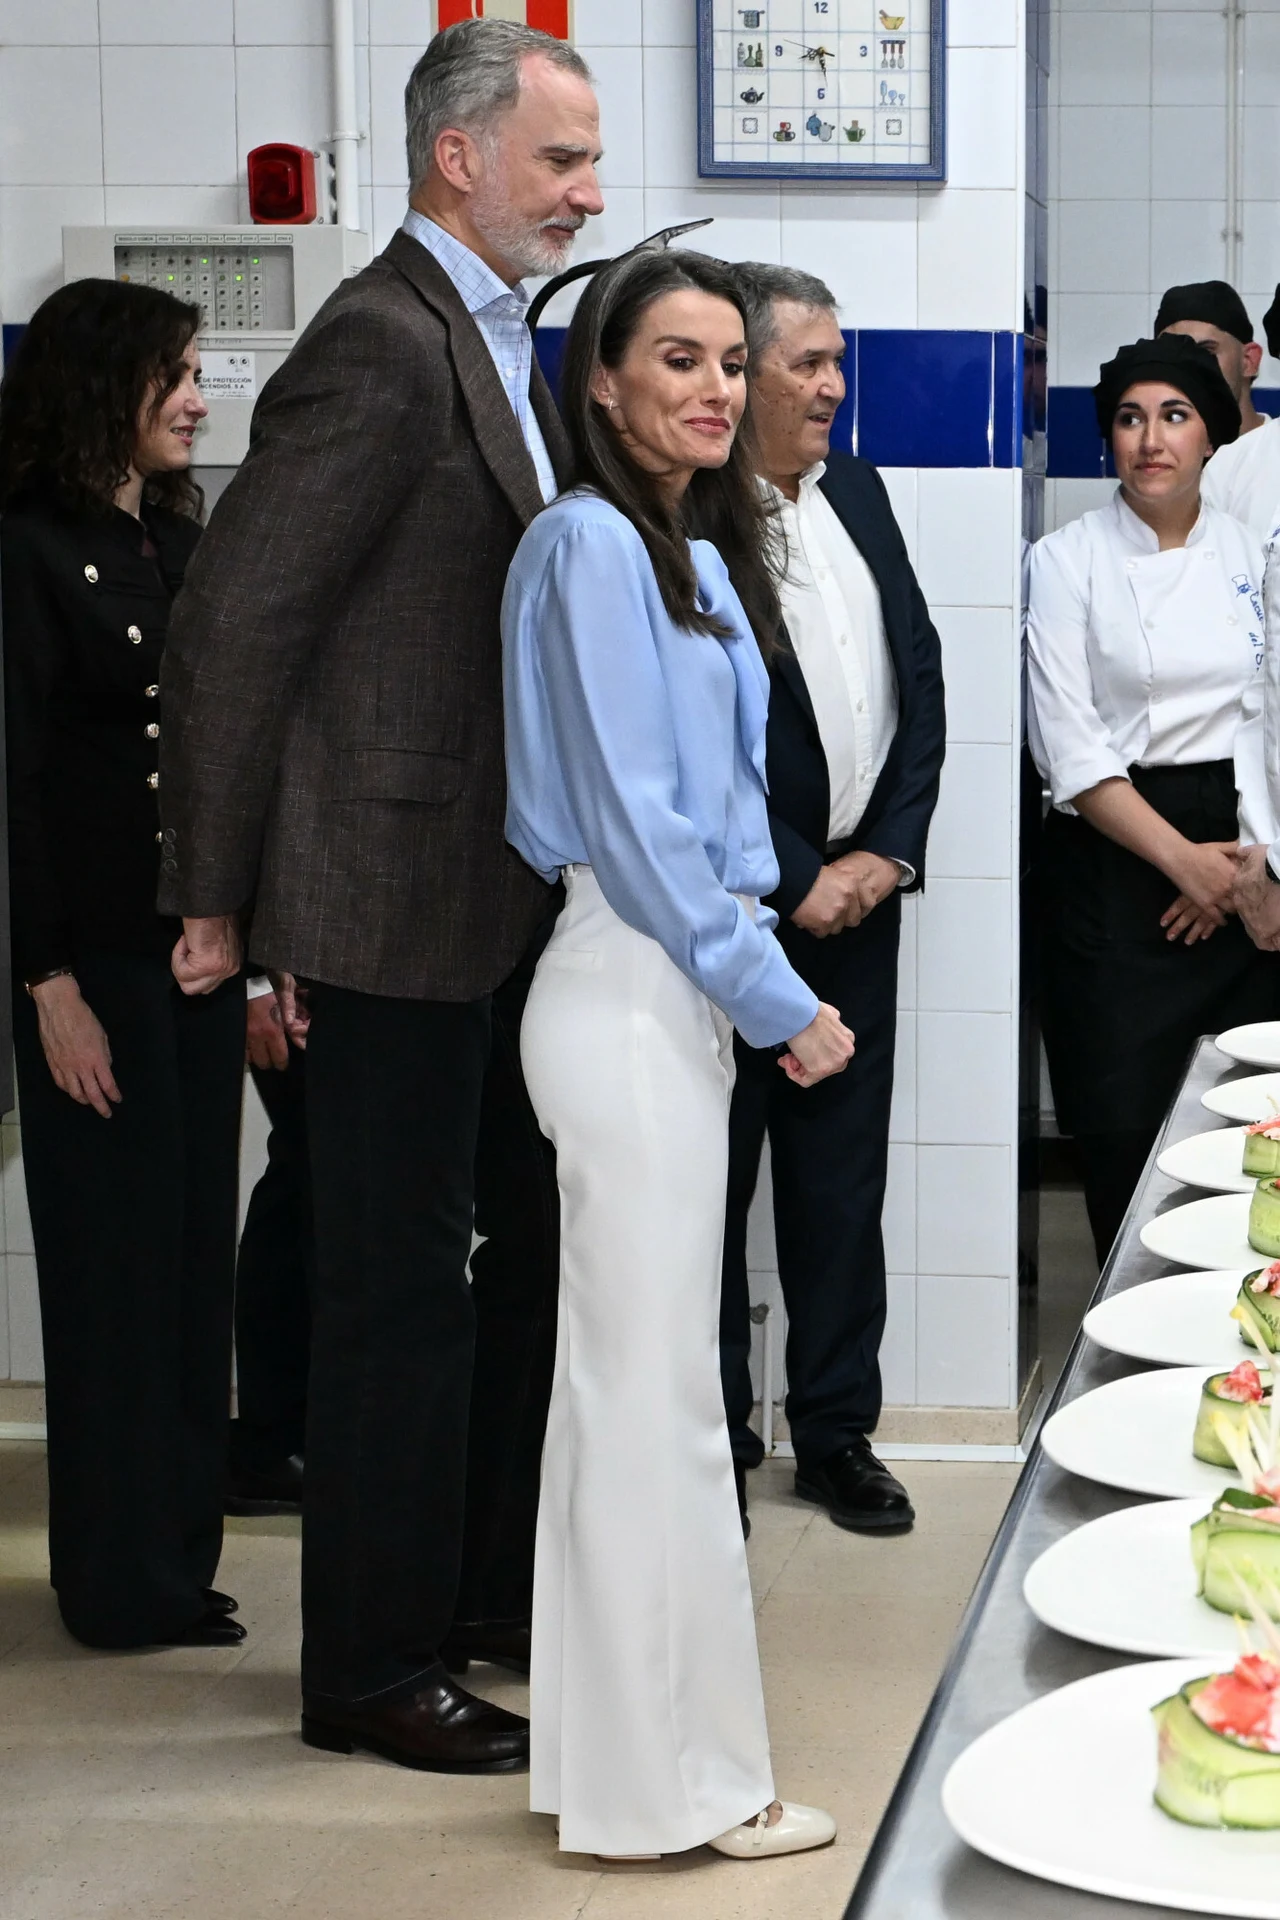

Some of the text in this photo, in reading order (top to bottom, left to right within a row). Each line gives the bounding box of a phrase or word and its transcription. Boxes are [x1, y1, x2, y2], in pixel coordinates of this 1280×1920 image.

[814, 2, 828, 13] 12
[775, 45, 783, 56] 9
[860, 46, 867, 57] 3
[817, 88, 825, 99] 6
